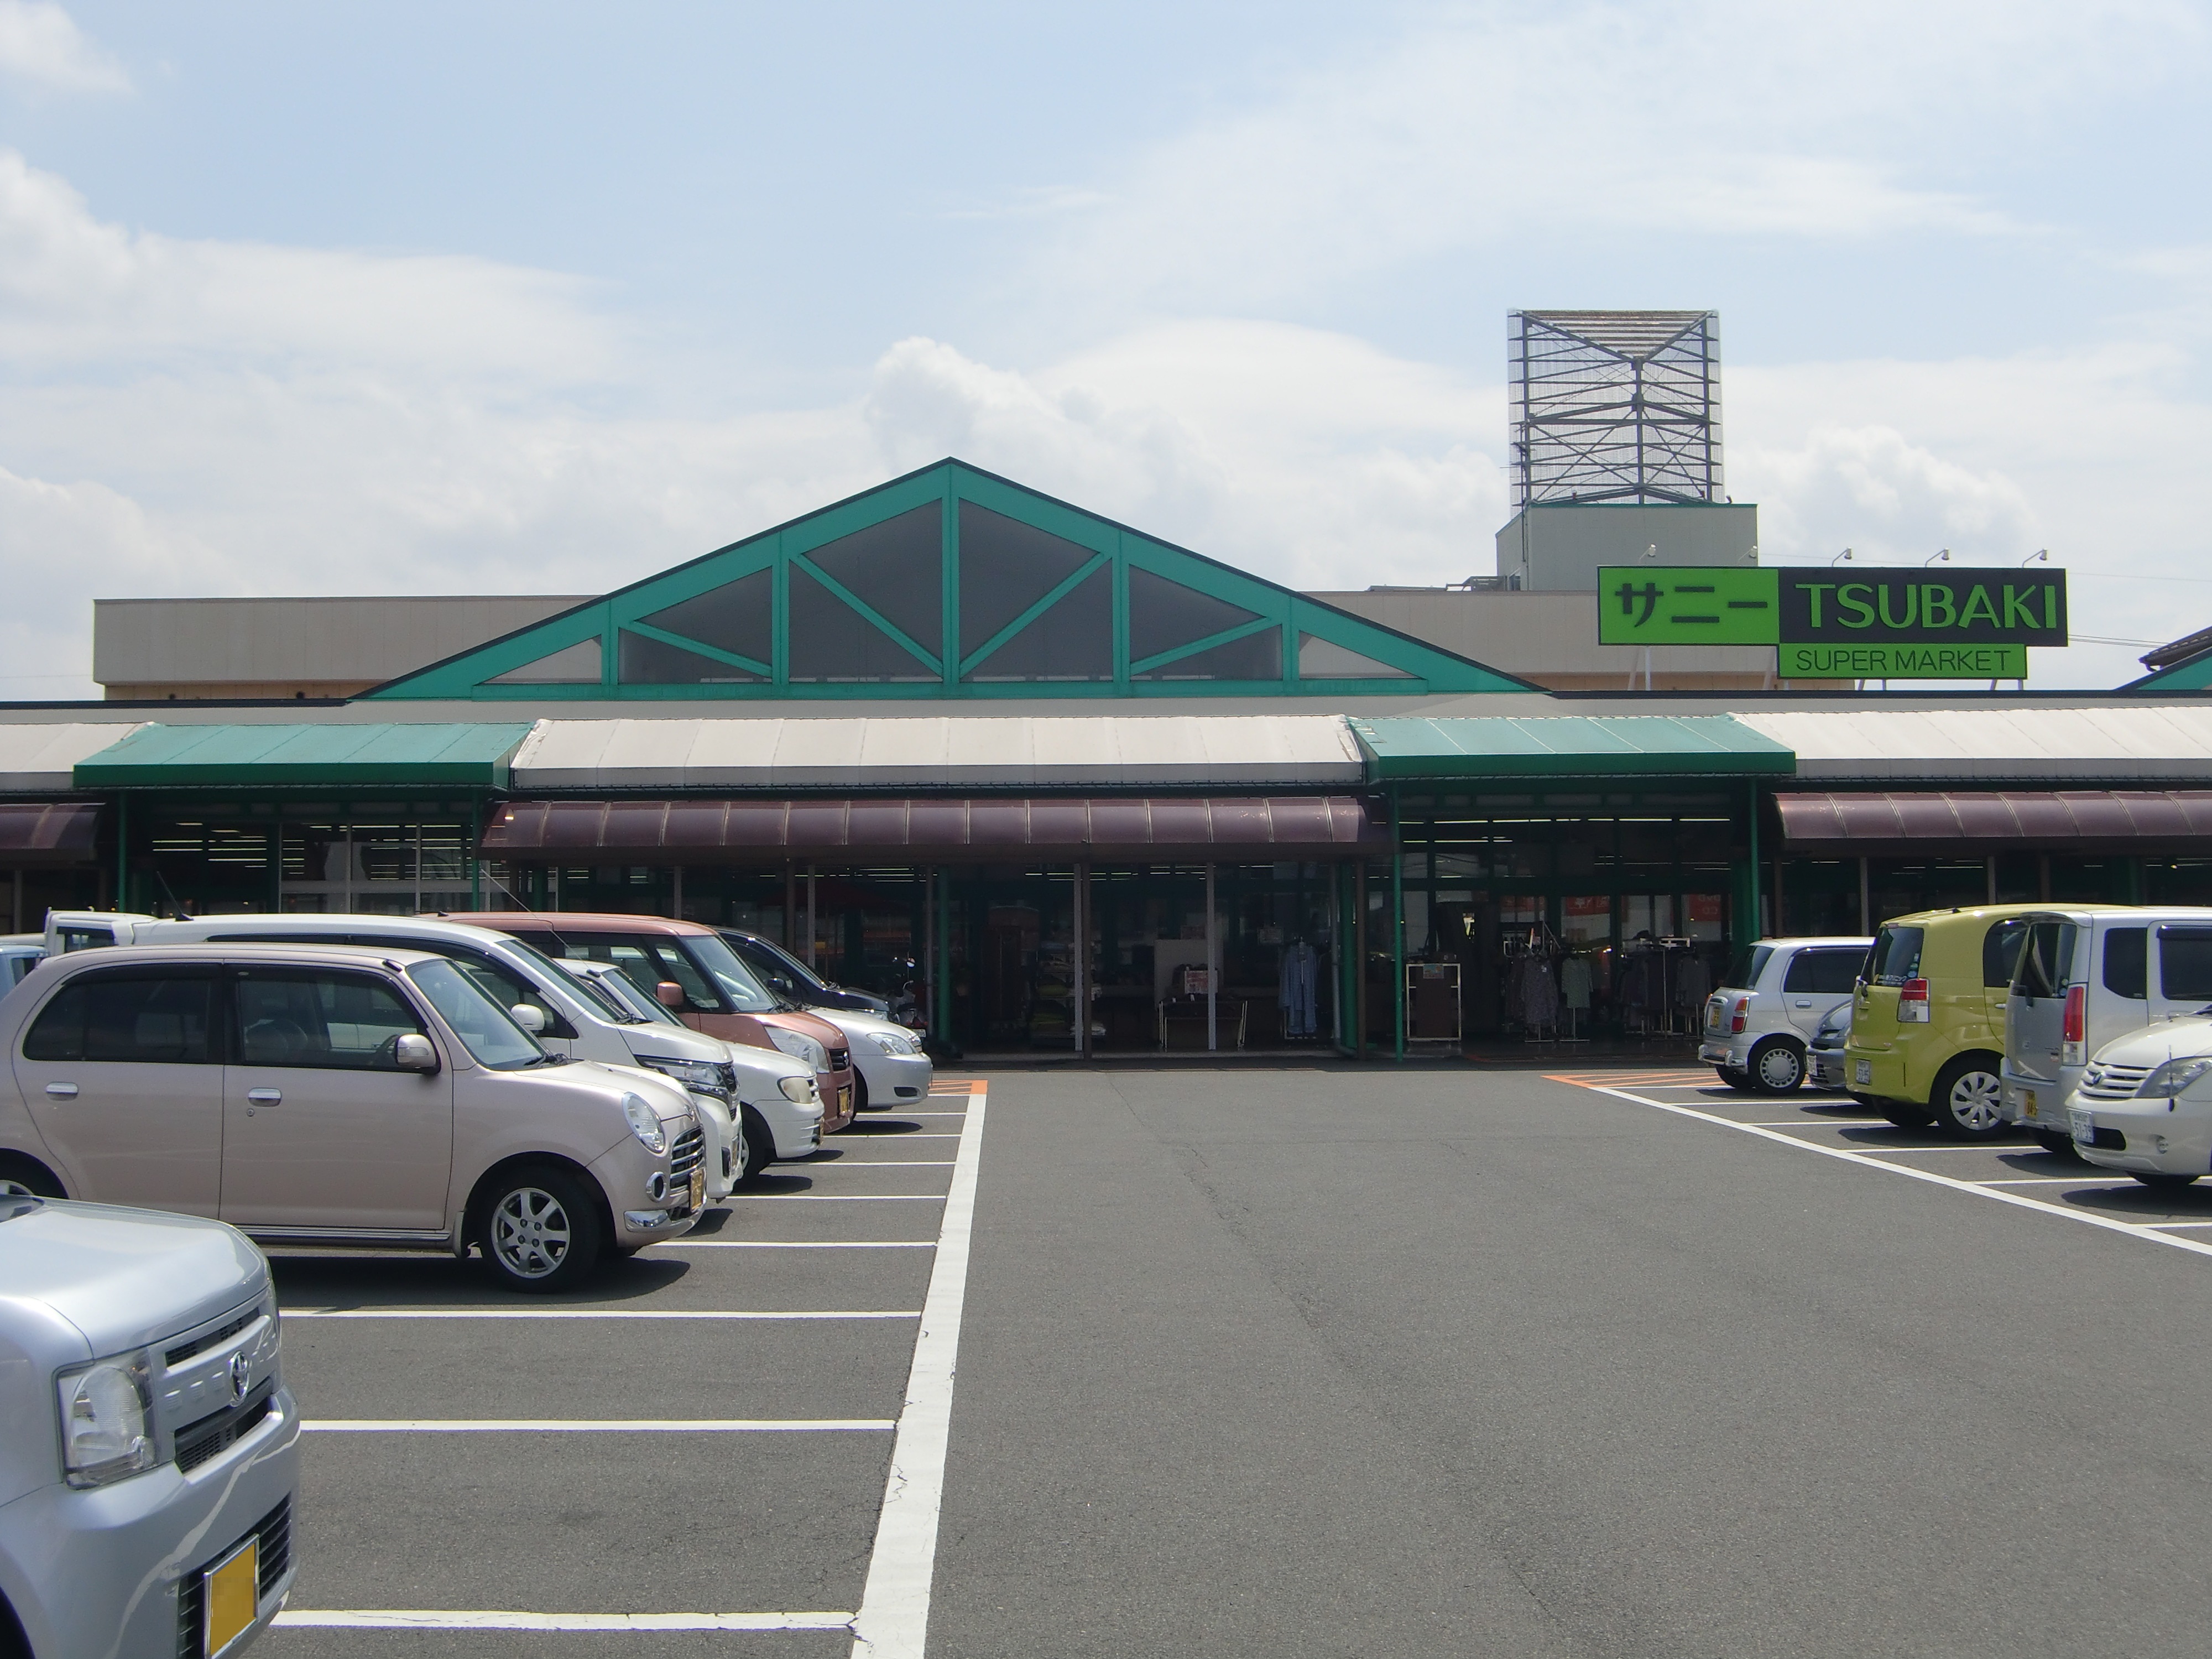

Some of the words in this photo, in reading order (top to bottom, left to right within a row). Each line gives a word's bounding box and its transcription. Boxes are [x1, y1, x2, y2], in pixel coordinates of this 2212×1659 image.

[1614, 582, 1768, 628] サニー
[1795, 584, 2056, 629] TSUBAKI
[1796, 650, 1888, 671] SUPER
[1895, 650, 2012, 671] MARKET
